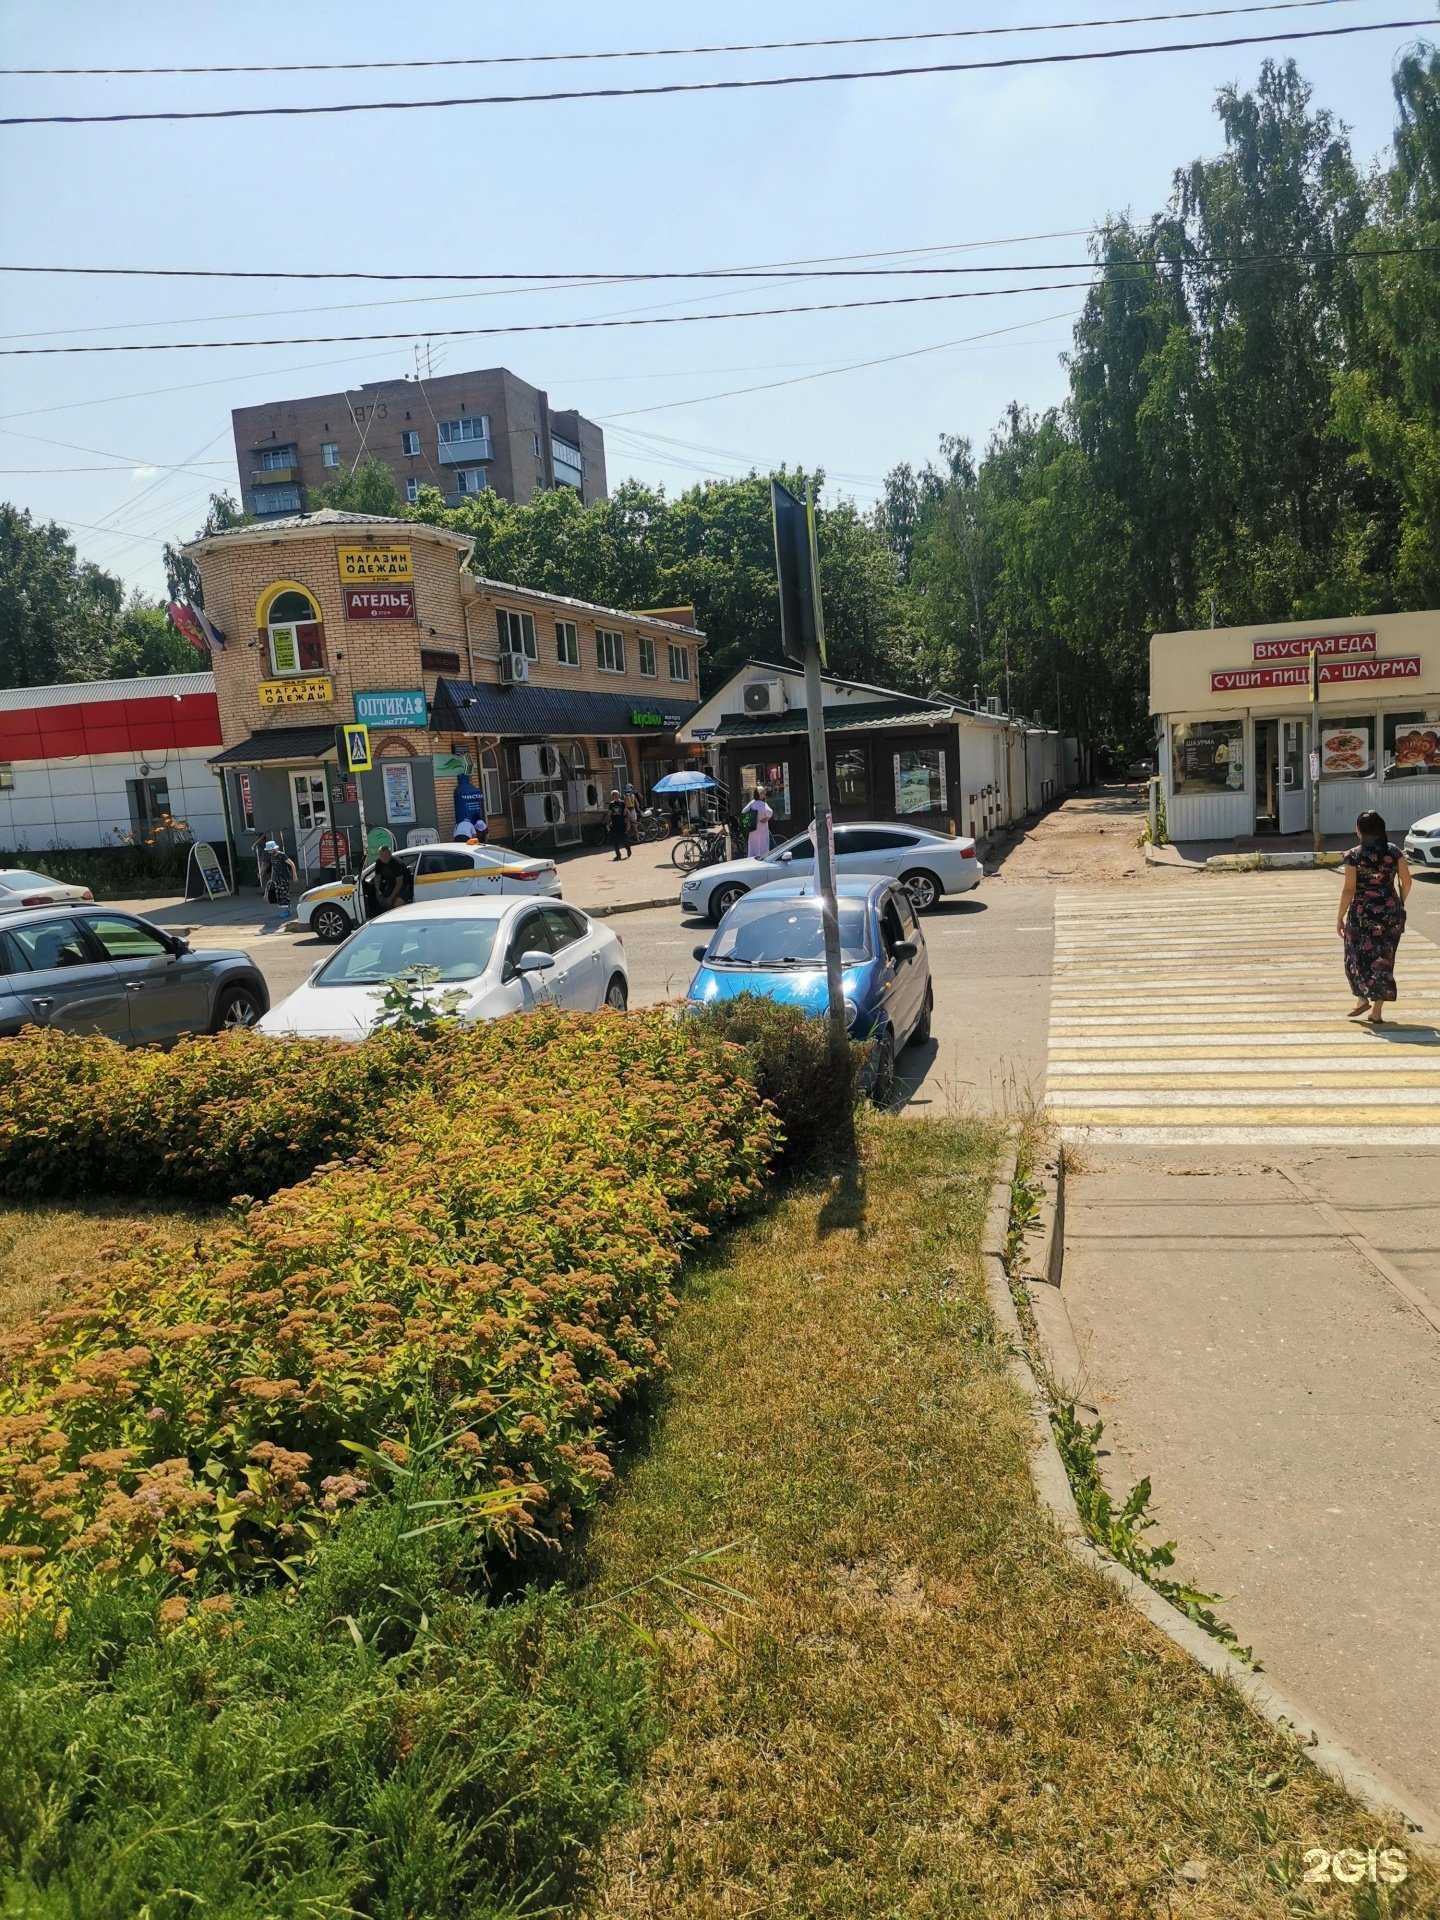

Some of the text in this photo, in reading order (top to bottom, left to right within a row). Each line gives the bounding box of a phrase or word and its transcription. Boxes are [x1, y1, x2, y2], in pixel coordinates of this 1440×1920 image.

[346, 554, 407, 564] МАГАЗИН
[346, 564, 408, 575] ОДЕЖДЫ
[351, 594, 410, 608] АТЕЛЬЕ
[1255, 636, 1375, 658] ВКУСНАЯ ЕДА
[1213, 661, 1418, 689] СУШИ ПИЦА ШАУРМА
[265, 685, 326, 696] МАГАЗИН
[266, 692, 327, 704] ОДЕЖДЫ
[358, 697, 415, 717] ОПТИКА
